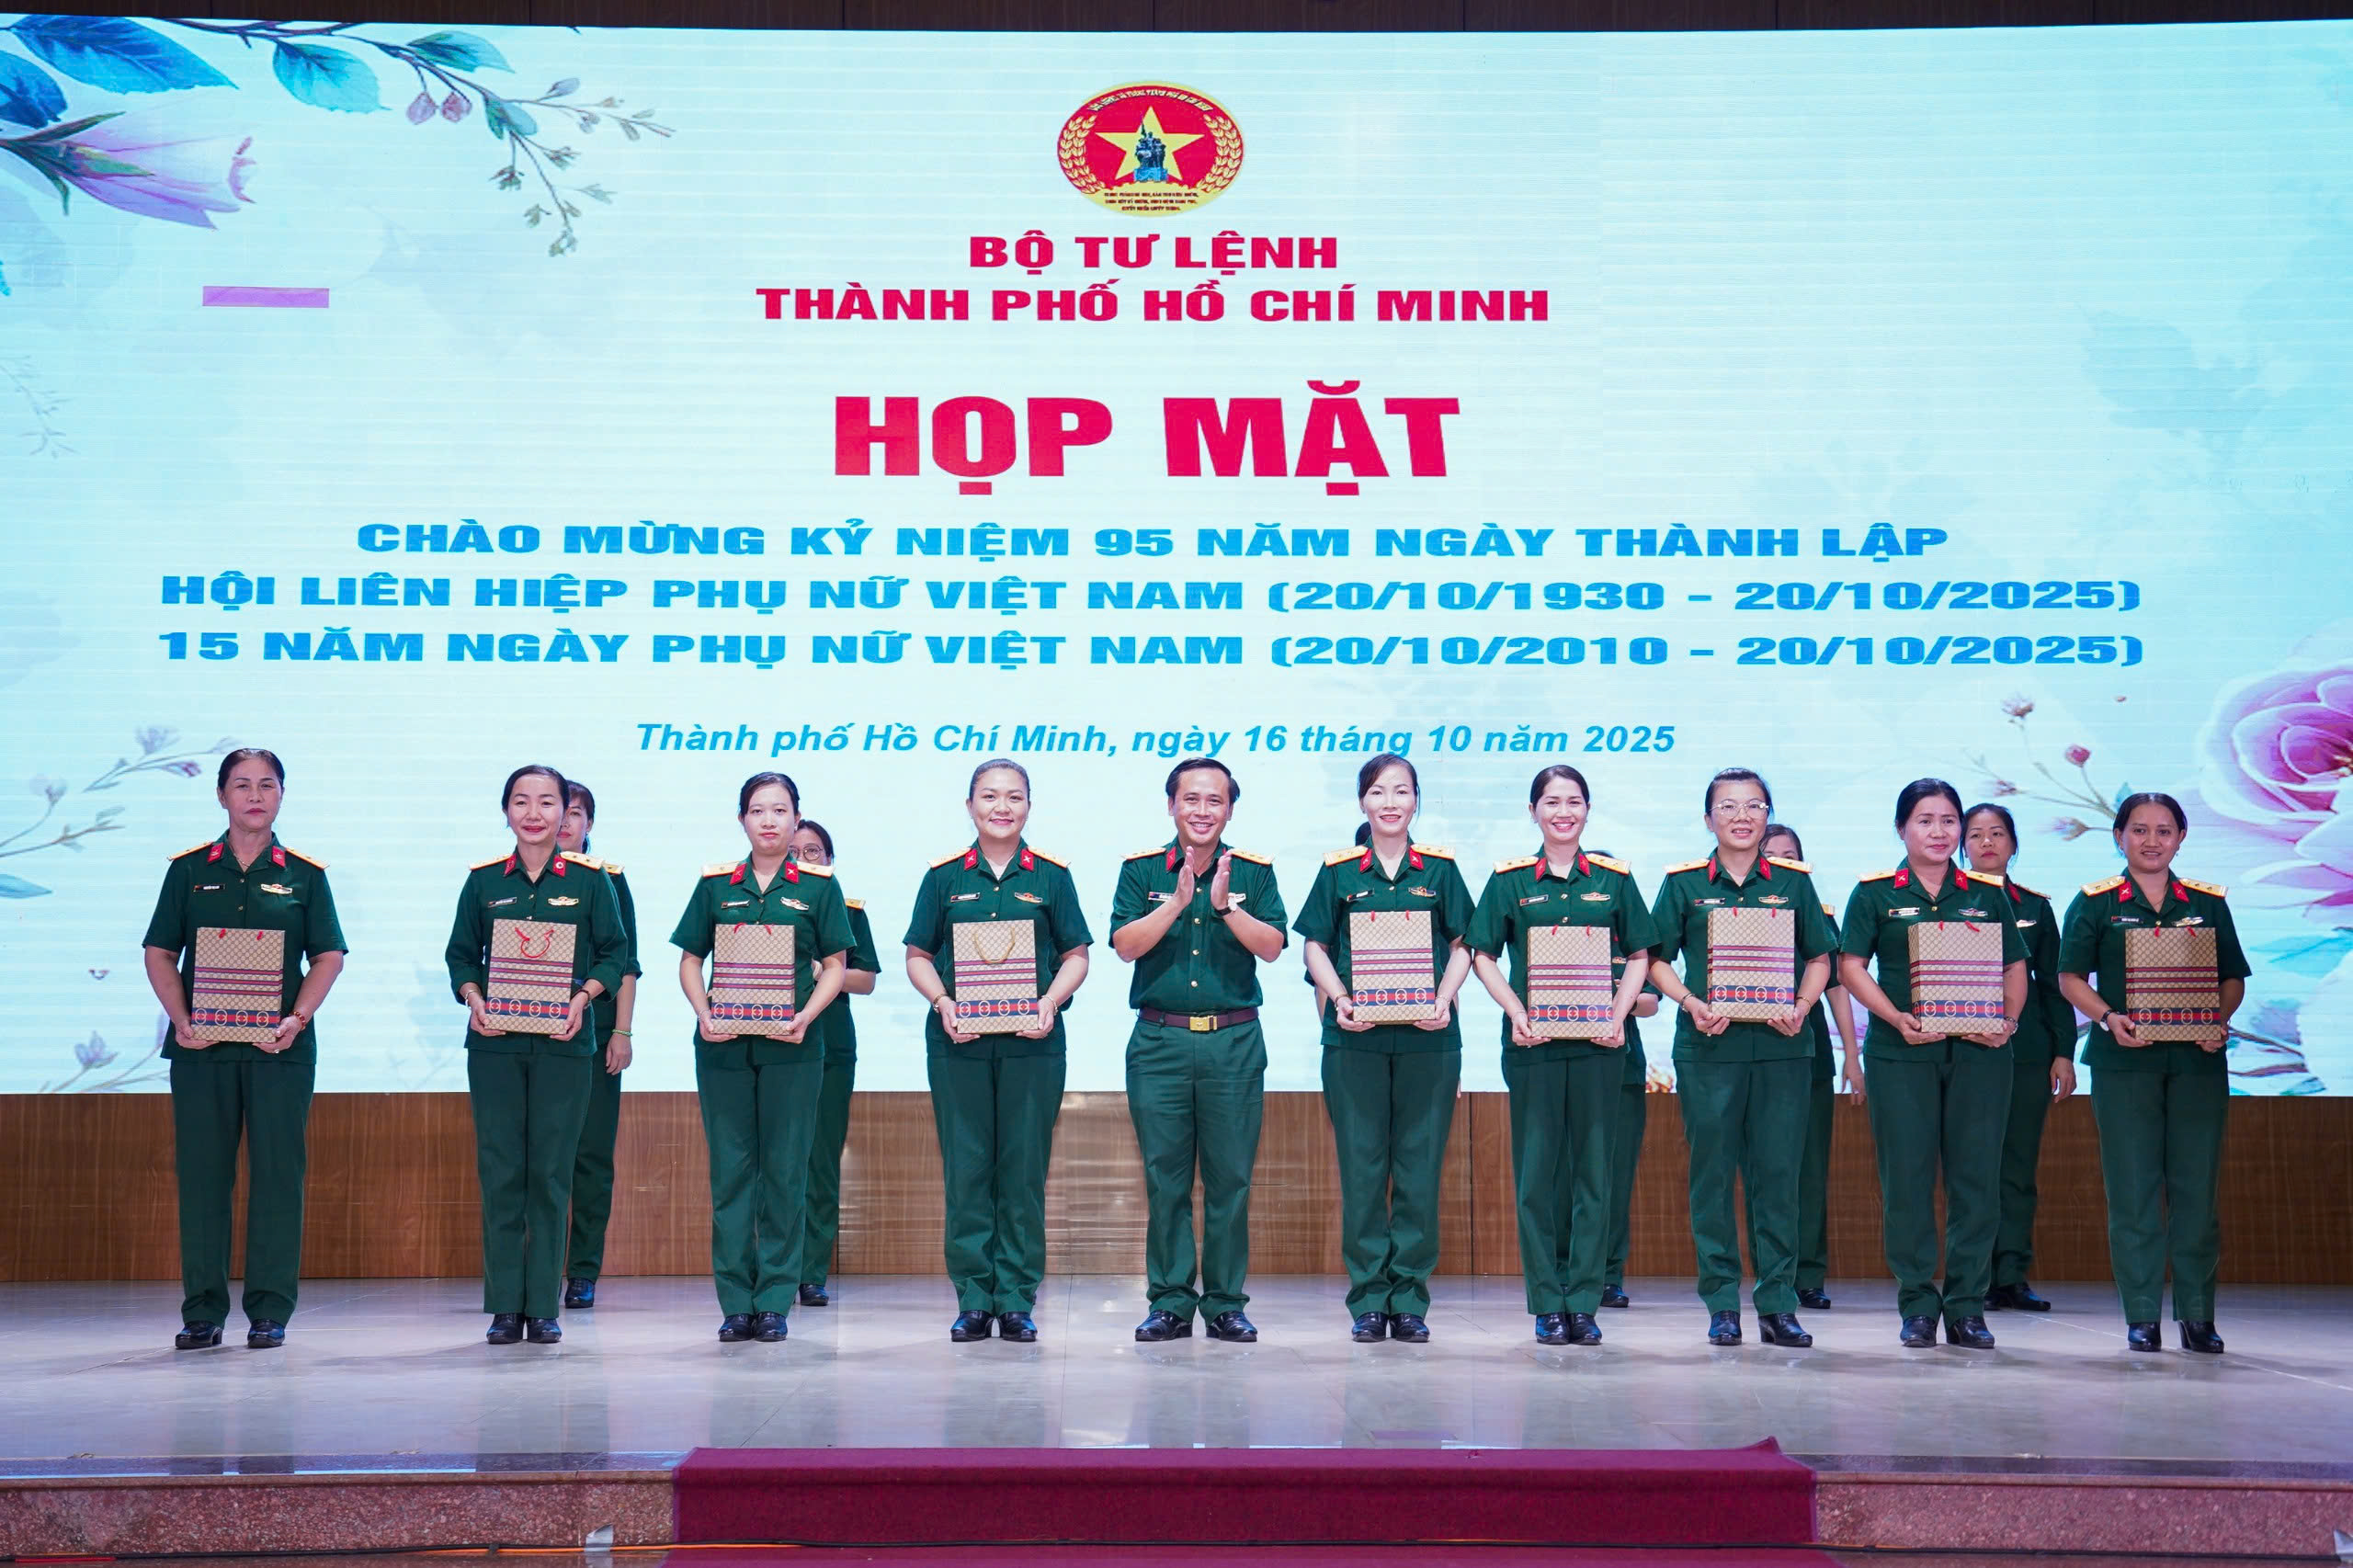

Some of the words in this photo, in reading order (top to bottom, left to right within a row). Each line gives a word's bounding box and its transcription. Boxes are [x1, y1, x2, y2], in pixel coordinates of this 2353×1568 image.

[971, 231, 1054, 276] BỘ
[1075, 233, 1160, 268] TƯ
[1176, 231, 1338, 276] LỆNH
[756, 283, 969, 321] THÀNH
[993, 278, 1120, 322] PHỐ
[1144, 280, 1225, 322] HỒ
[1250, 283, 1356, 322] CHÍ
[1378, 290, 1549, 322] MINH
[835, 396, 1113, 495] HỌP
[1163, 380, 1461, 496] MẶT
[358, 520, 540, 554] CHÀO
[564, 520, 766, 555] MỪNG
[790, 517, 876, 556] KỶ
[896, 523, 1070, 562] NIỆM
[1095, 528, 1176, 557] 95
[1198, 523, 1350, 557] NĂM
[1375, 523, 1555, 557] NGÀY
[1575, 523, 1800, 557] THÀNH
[1821, 523, 1949, 563] LẬP
[161, 570, 276, 611] HỘI
[301, 572, 451, 608] LIÊN
[475, 573, 629, 614] HIỆP
[654, 580, 788, 615] PHỤ
[810, 576, 910, 610] NỮ
[926, 576, 1068, 616] VIỆT
[1088, 581, 1245, 611] NAM
[1268, 581, 1666, 612] (20/10/1930
[1734, 581, 2142, 613] 20/10/2025)
[159, 631, 240, 662] 15
[263, 627, 425, 663] NĂM
[447, 629, 631, 664] NGÀY
[654, 634, 788, 670] PHỤ
[812, 630, 914, 665] NỮ
[926, 630, 1068, 671] VIỆT
[1090, 636, 1245, 665] NAM
[1271, 636, 1669, 668] (20/10/2010
[1737, 636, 2144, 668] 20/10/2025)
[637, 724, 758, 751] Thành
[770, 722, 856, 758] phố
[863, 722, 919, 752] Hồ
[934, 724, 1001, 752] Chí
[1011, 724, 1119, 756] Minh,
[1131, 725, 1233, 759] ngày
[1244, 725, 1289, 752] 16
[1301, 725, 1414, 757] tháng
[1427, 725, 1472, 752] 10
[1483, 725, 1570, 752] năm
[1584, 725, 1676, 752] 2025
